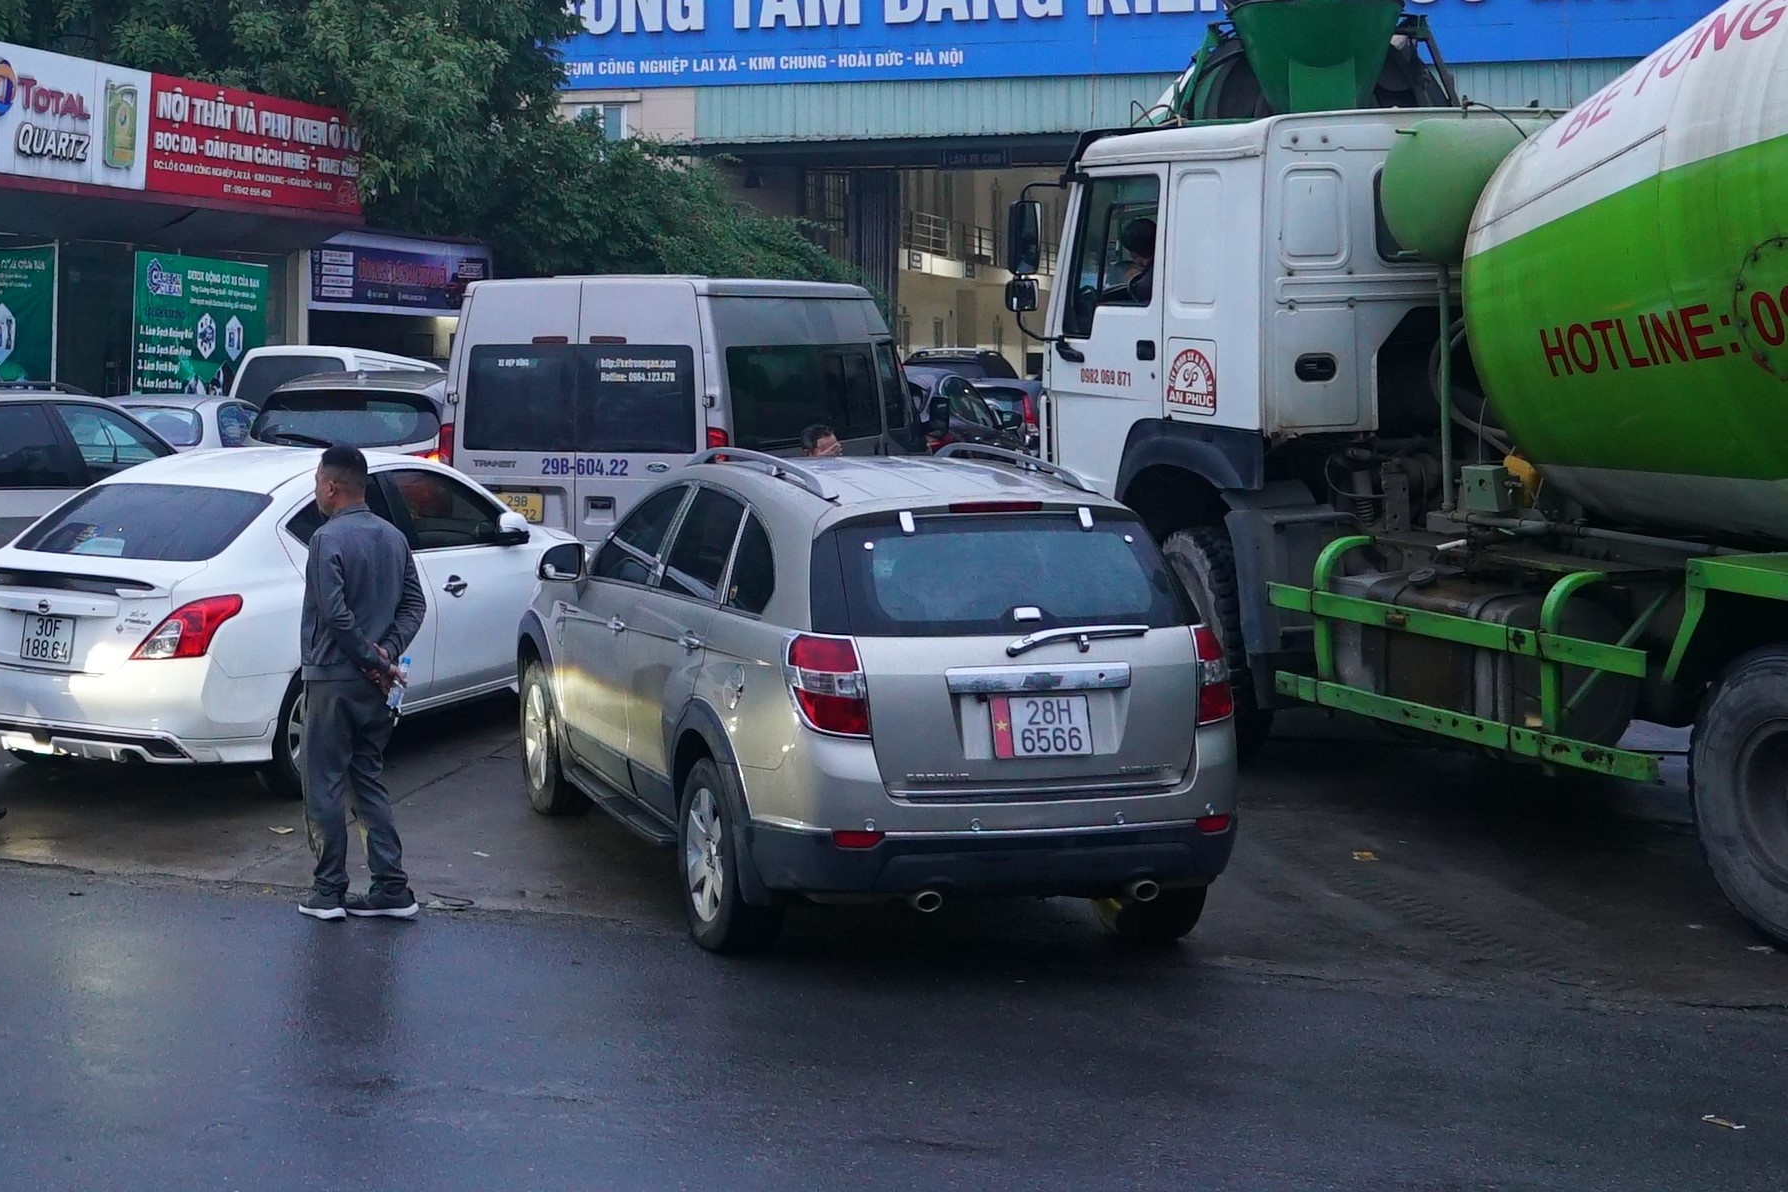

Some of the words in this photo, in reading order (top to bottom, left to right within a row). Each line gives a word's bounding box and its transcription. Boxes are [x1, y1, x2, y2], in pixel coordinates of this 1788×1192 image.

[599, 59, 635, 75] CÔNG
[640, 57, 688, 76] NGHIỆP
[693, 58, 715, 72] LAI
[718, 55, 737, 71] XÁ
[749, 56, 775, 70] KIM
[780, 55, 826, 69] CHUNG
[838, 51, 871, 67] HOÀI
[875, 49, 903, 66] ĐỨC
[915, 49, 934, 65] HÀ
[939, 47, 963, 67] NỘI
[18, 76, 90, 120] TOTAL
[156, 87, 190, 128] NỘI
[191, 90, 234, 130] THẤT
[235, 101, 257, 134] VÀ
[259, 111, 292, 146] PHỤ
[329, 116, 341, 148] Ô
[17, 122, 90, 161] QUARTZ
[154, 132, 180, 156] BỌC
[181, 137, 197, 155] DA
[205, 135, 228, 159] DÁN
[230, 142, 253, 163] FILM
[254, 142, 282, 167] CÁCH
[283, 149, 311, 174] NHIỆT
[1540, 304, 1741, 378] HOTLINE:
[1750, 285, 1788, 346] 0
[1117, 371, 1131, 387] 871
[1169, 390, 1183, 402] AN
[541, 458, 629, 476] 29B-604.22
[35, 617, 62, 638] 30F
[25, 637, 68, 660] 188.64
[1026, 699, 1072, 725] 28H
[1021, 727, 1082, 753] 6566
